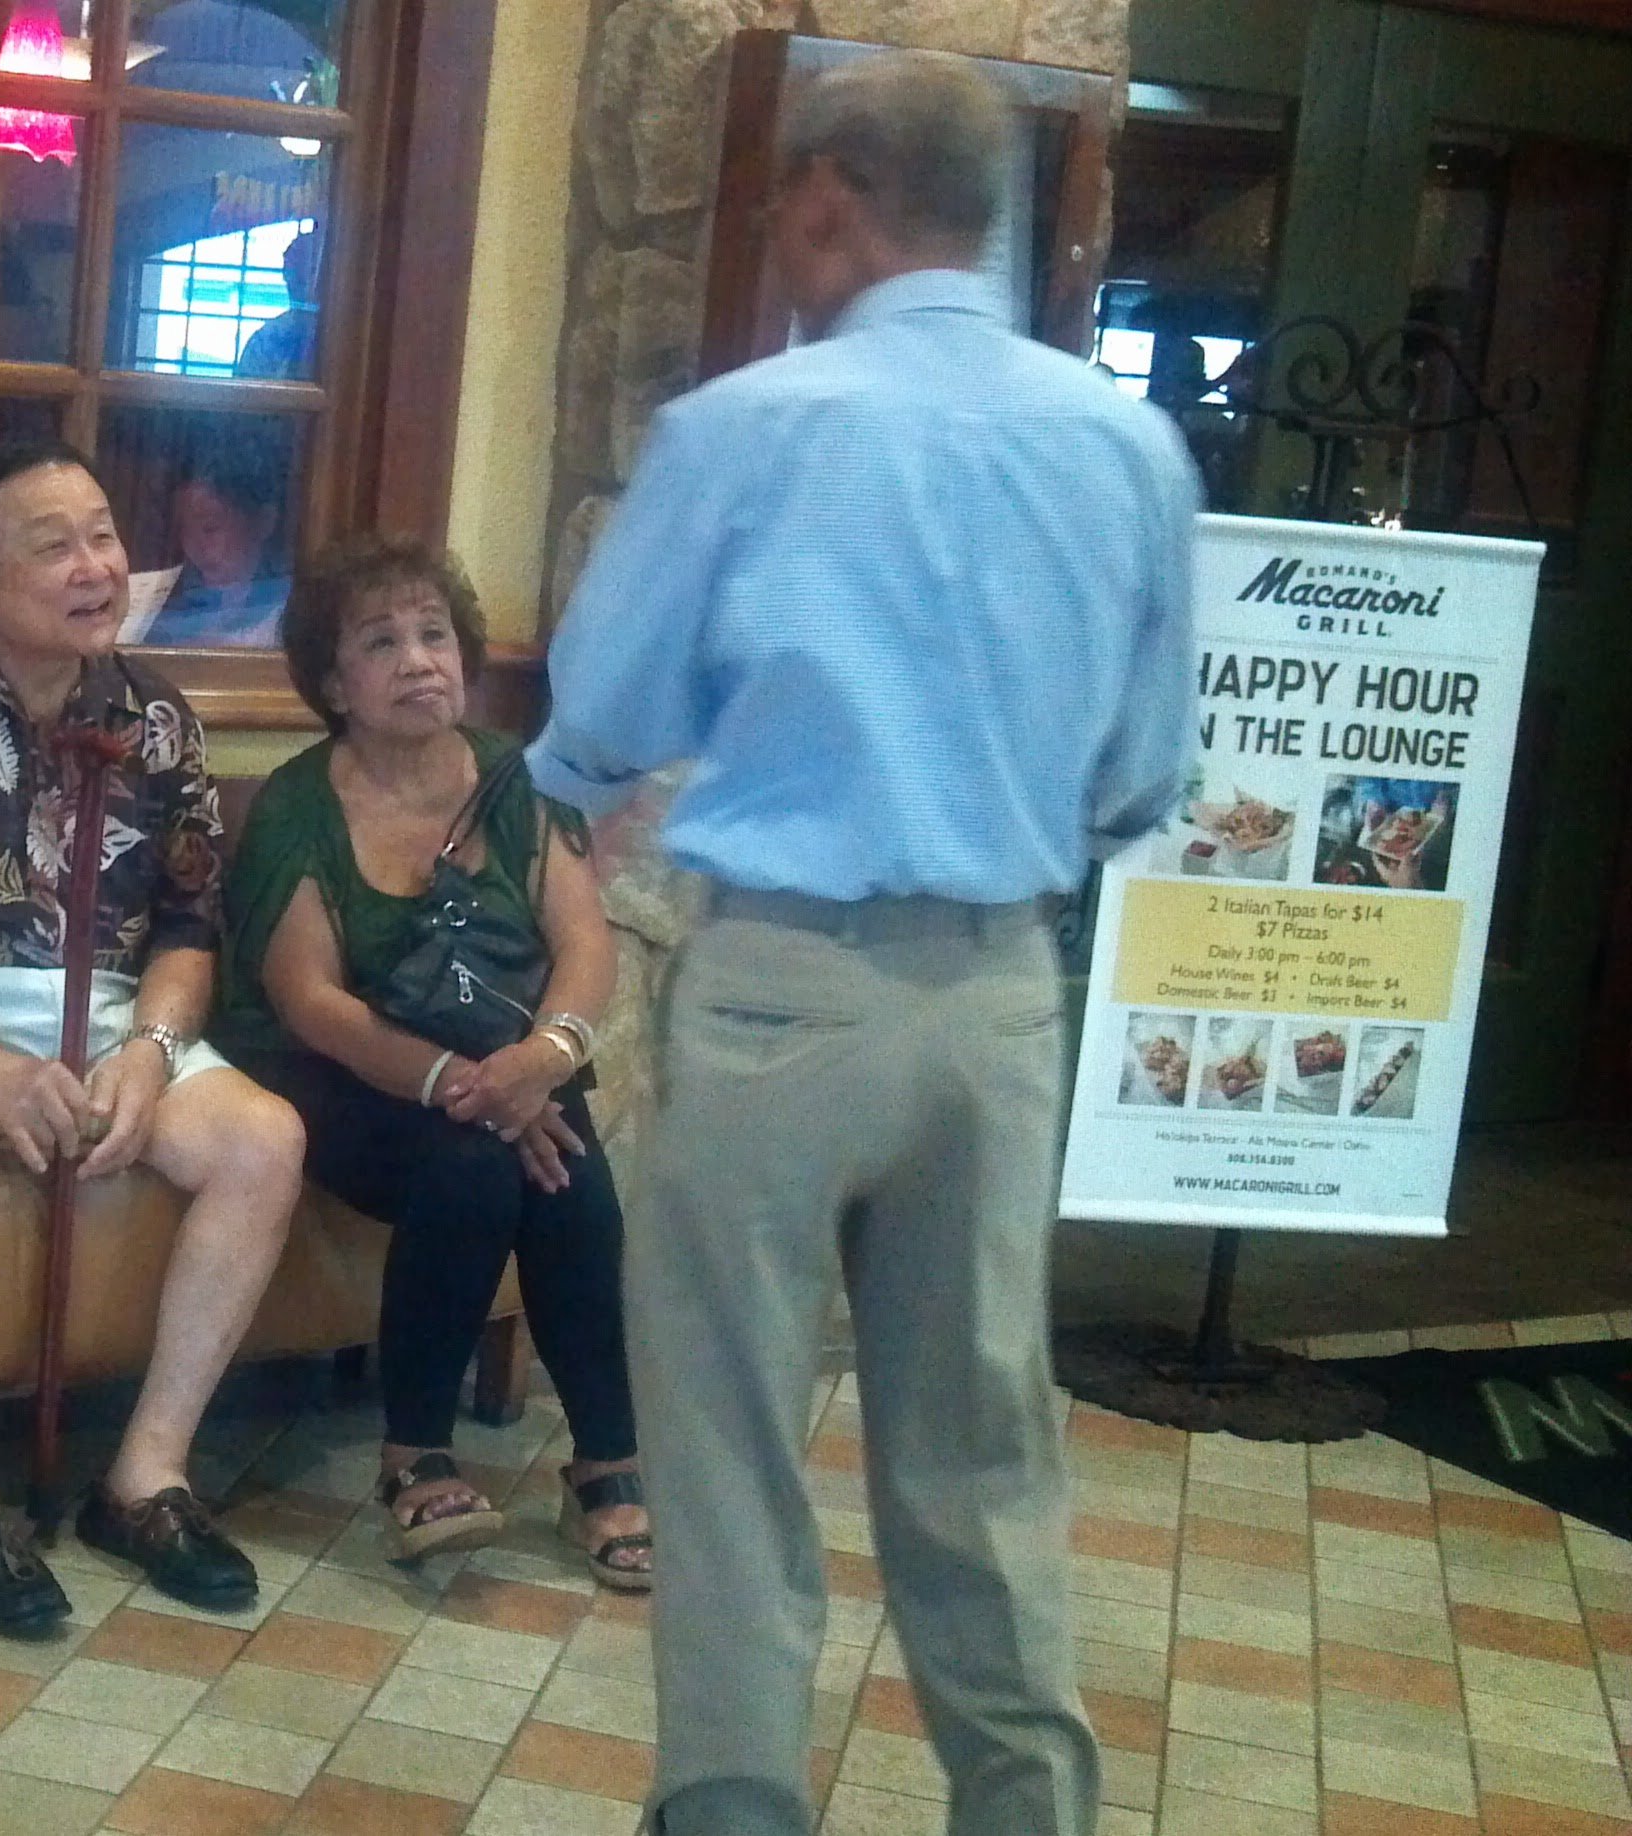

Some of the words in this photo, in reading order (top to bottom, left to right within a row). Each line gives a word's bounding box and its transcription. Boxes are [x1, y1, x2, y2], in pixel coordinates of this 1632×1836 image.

[1305, 564, 1397, 586] ROMANO'S
[1236, 557, 1445, 617] Macaroni
[1296, 614, 1389, 638] GRILL
[1356, 665, 1479, 717] HOUR
[1235, 714, 1306, 756] THE
[1320, 722, 1470, 768] LOUNGE
[1207, 895, 1218, 913] 2
[1224, 897, 1270, 916] Italian
[1276, 900, 1318, 921] Tapas
[1323, 903, 1347, 920] for
[1351, 904, 1383, 924] $14
[1257, 920, 1277, 939] $7
[1282, 922, 1329, 941] Pizzas
[1208, 944, 1242, 962] Daily
[1278, 953, 1300, 967] pm
[1316, 951, 1346, 966] 6:00
[1348, 956, 1371, 970] pm
[1170, 963, 1213, 980] House
[1216, 967, 1255, 982] Wines
[1346, 974, 1378, 989] Beer
[1224, 986, 1252, 1001] Beer
[1354, 994, 1384, 1009] Beer
